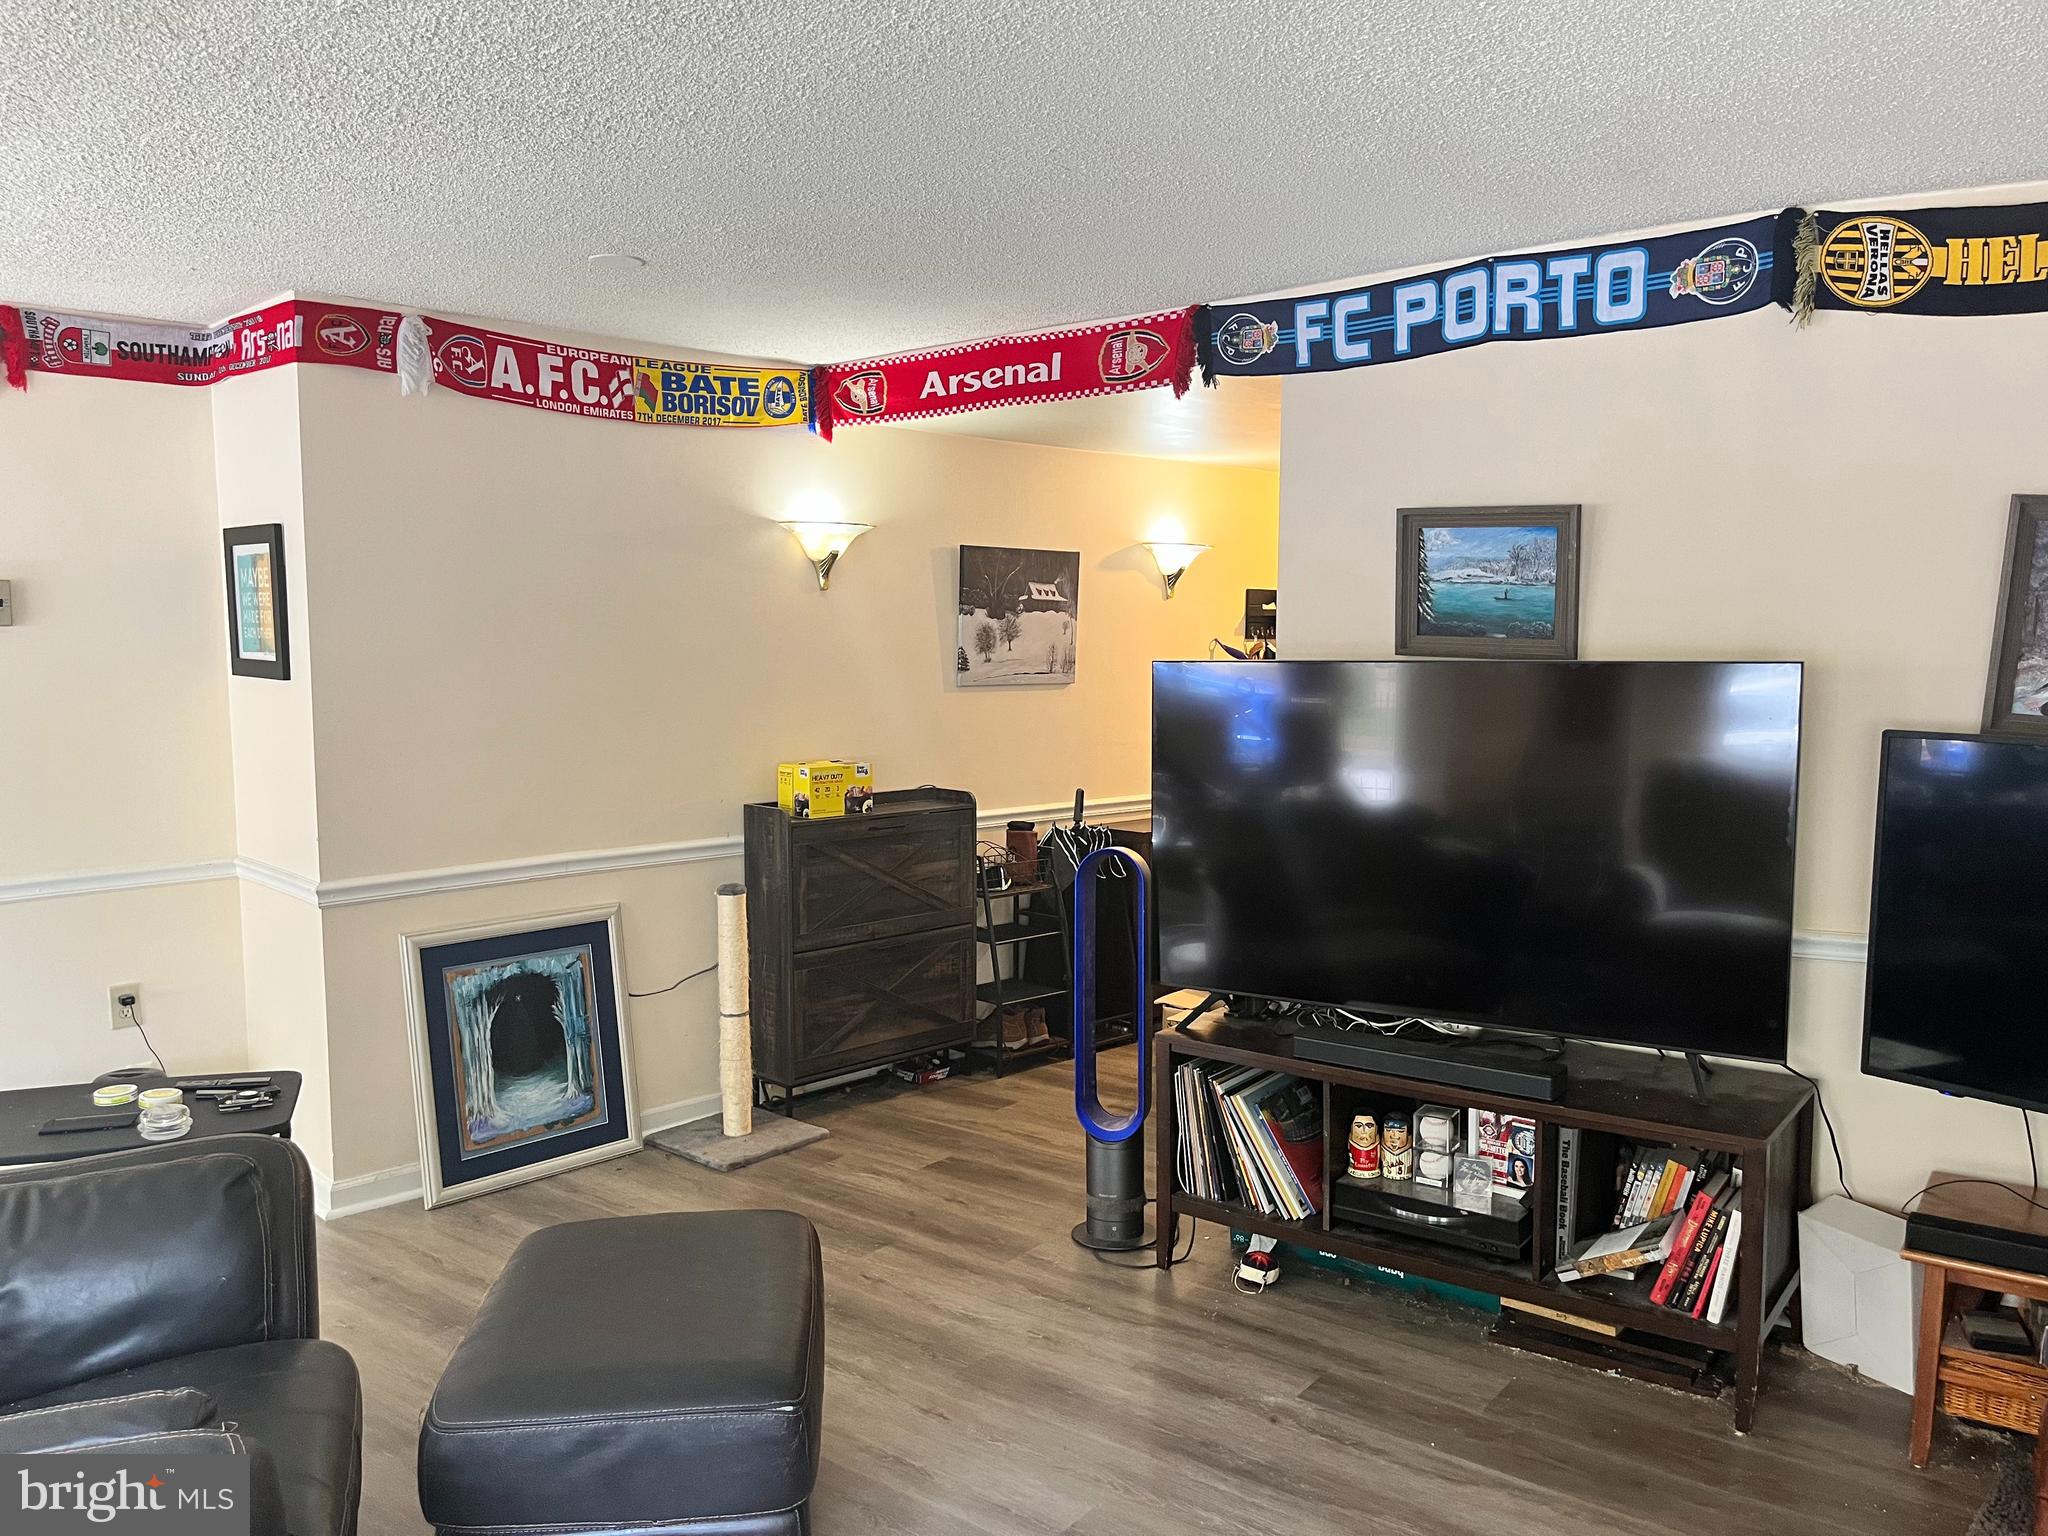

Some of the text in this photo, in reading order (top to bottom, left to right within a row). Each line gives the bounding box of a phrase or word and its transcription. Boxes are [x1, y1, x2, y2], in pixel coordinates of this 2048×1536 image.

[1860, 224, 1878, 298] VERONA
[1877, 229, 1890, 296] HELLAS
[1294, 247, 1649, 367] FC PORTO
[546, 344, 711, 374] EUROPEAN LEAGUE
[1109, 338, 1123, 375] Arsenal
[490, 345, 608, 406] A.F.C.
[660, 371, 761, 396] BATE
[919, 352, 1062, 399] Arsenal
[661, 390, 760, 418] BORISOV
[868, 376, 880, 409] Arsenal
[536, 398, 634, 420] LONDON EMIRATES
[637, 412, 722, 426] 7TH DECEMBER 2017
[240, 567, 270, 588] MAYBE
[812, 774, 829, 782] HEAVY
[1562, 1140, 1571, 1159] The
[1560, 1160, 1570, 1204] Baseball
[1558, 1204, 1568, 1231] Book
[1706, 1209, 1719, 1232] MIKE
[1694, 1230, 1710, 1253] LUPICA
